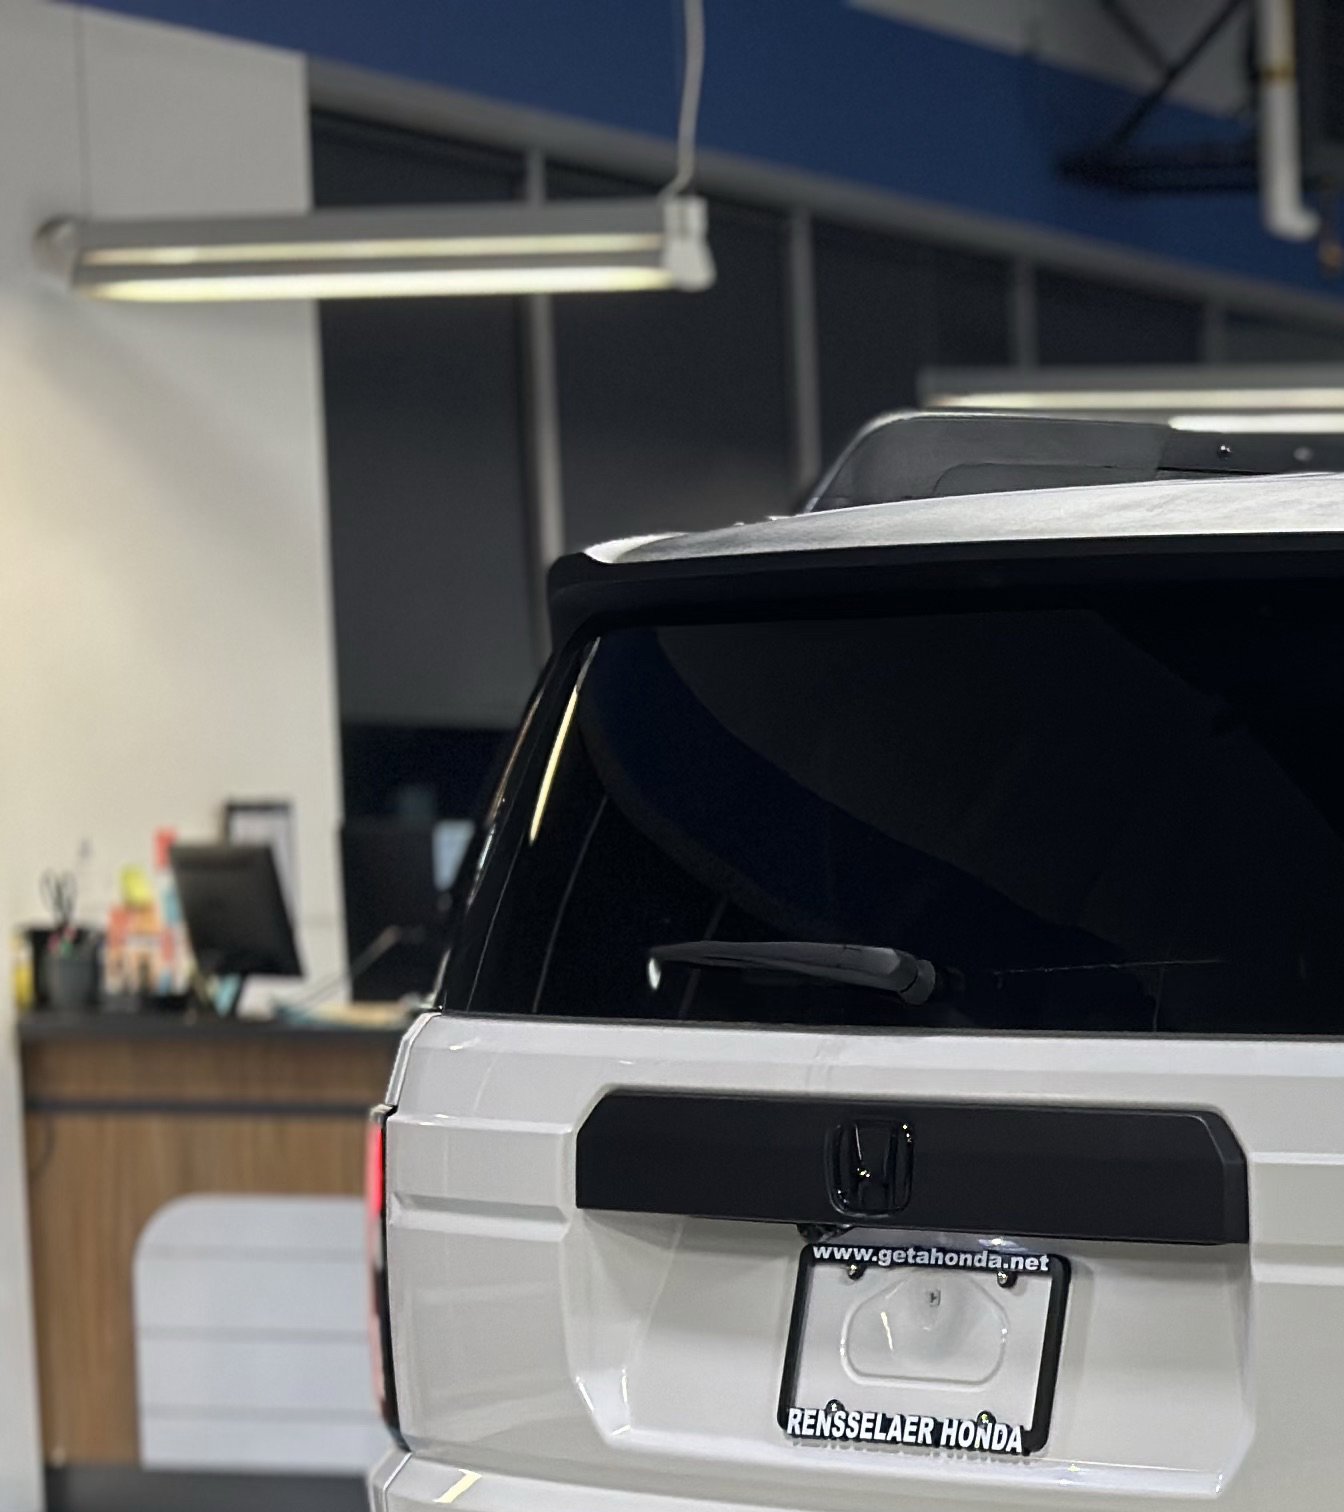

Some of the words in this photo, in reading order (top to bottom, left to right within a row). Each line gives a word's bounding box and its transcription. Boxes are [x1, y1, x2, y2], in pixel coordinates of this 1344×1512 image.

[813, 1246, 1049, 1272] www.getahonda.net
[787, 1408, 935, 1445] RENSSELAER
[940, 1419, 1022, 1453] HONDA
